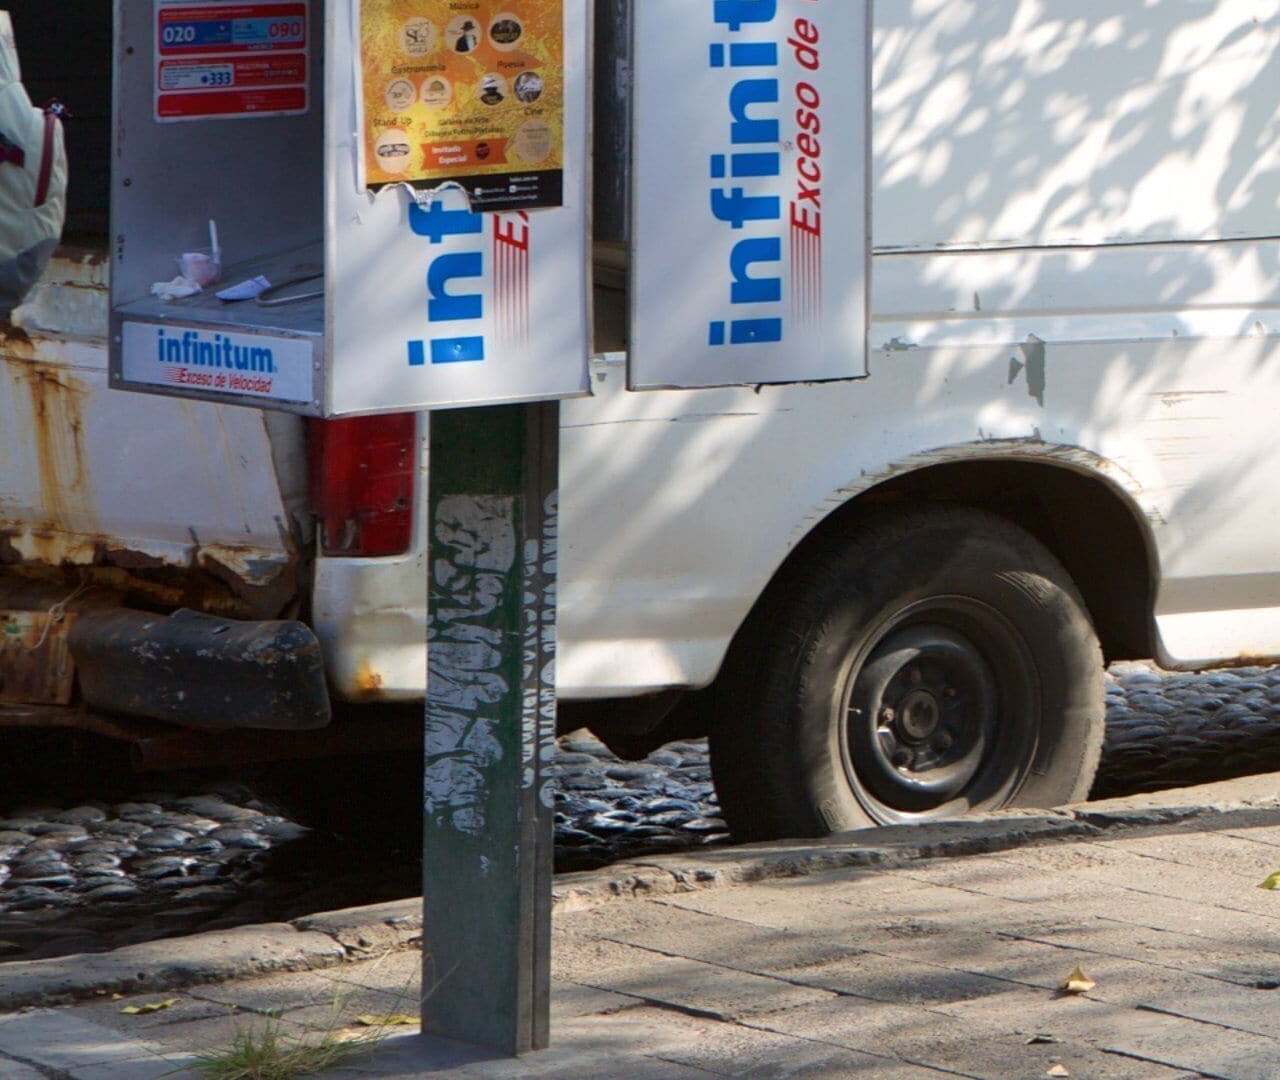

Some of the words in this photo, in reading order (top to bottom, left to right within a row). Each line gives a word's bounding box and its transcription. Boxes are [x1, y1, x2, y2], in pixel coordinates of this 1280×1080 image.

[163, 26, 195, 43] 020
[787, 18, 820, 71] de
[789, 80, 822, 238] Exceso
[157, 328, 274, 373] infinitum
[179, 367, 212, 387] Exceso
[214, 372, 227, 388] de
[227, 372, 273, 393] Velocidad
